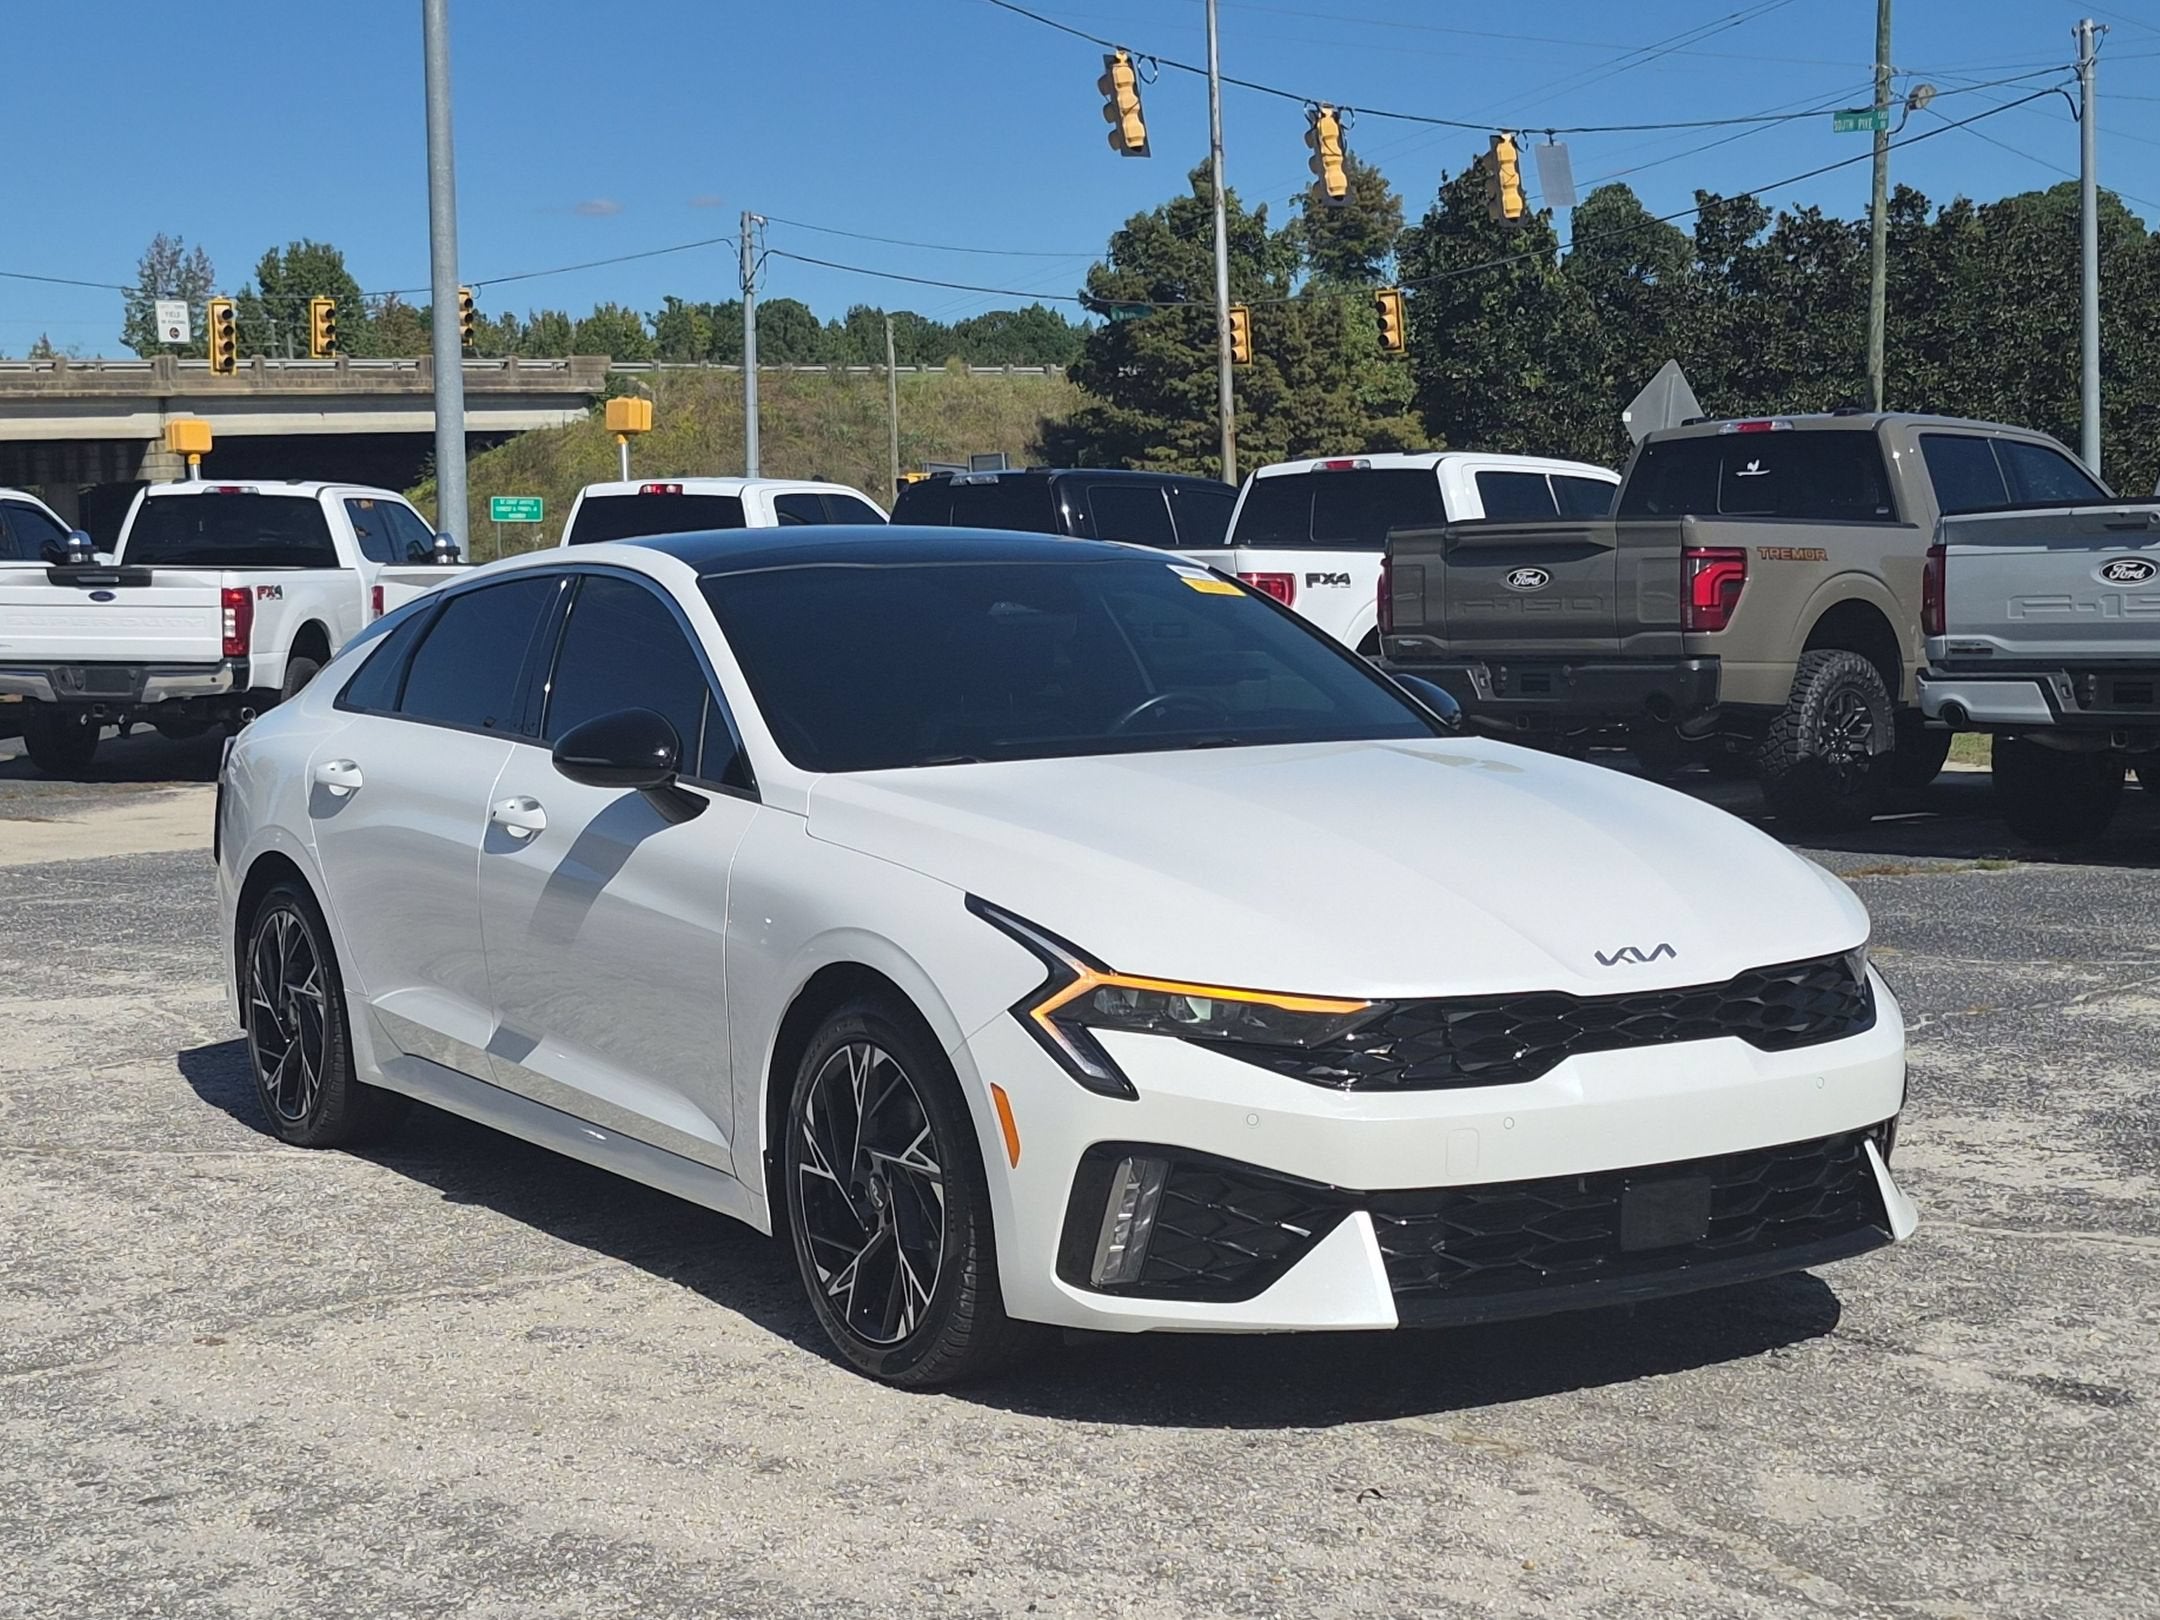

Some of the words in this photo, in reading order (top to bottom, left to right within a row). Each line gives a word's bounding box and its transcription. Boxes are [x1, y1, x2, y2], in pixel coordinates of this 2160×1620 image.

[1757, 546, 1828, 561] TREMOR
[1513, 571, 1541, 585] Ford
[2109, 564, 2146, 580] Ford
[1305, 572, 1351, 588] FX4
[257, 585, 283, 600] FX4
[1594, 943, 1677, 966] KIA
